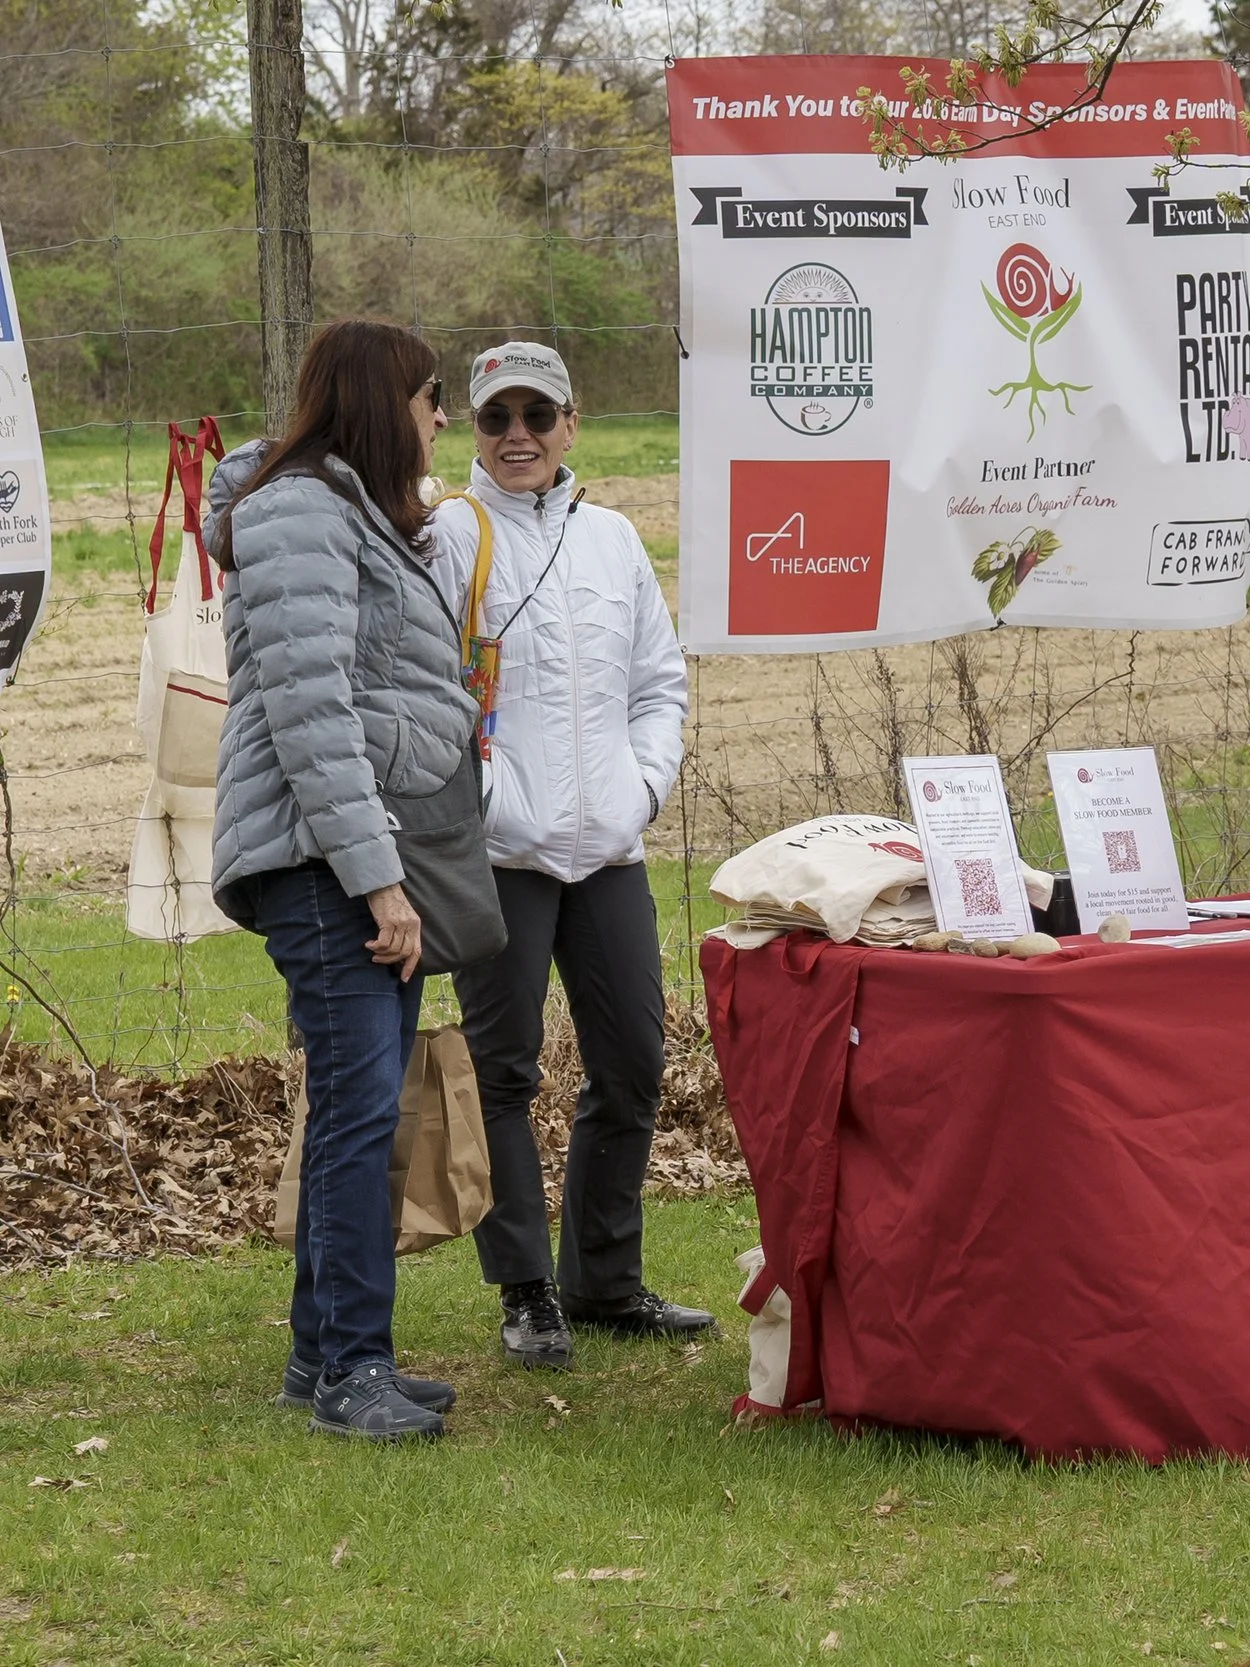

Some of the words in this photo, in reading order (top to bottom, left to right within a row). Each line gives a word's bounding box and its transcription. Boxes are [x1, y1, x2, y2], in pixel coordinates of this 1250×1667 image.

[693, 95, 779, 120] Thank
[785, 95, 833, 118] You
[840, 97, 865, 117] to
[912, 98, 948, 119] 206
[983, 101, 1022, 127] Day
[1028, 101, 1147, 128] Sponsors
[1153, 99, 1170, 120] &
[1175, 98, 1219, 120] Event
[952, 177, 1007, 209] Slow
[1013, 174, 1071, 209] Food
[735, 203, 806, 228] Event
[813, 202, 907, 235] Sponsors
[988, 214, 1019, 229] EAST
[1023, 213, 1047, 227] END
[1164, 203, 1213, 227] Event
[750, 306, 873, 364] HAMPTON
[504, 355, 527, 363] Slow
[750, 366, 873, 382] COFFEE
[755, 385, 869, 396] COMPANY
[980, 459, 1028, 482] Event
[1033, 456, 1096, 479] Partner
[946, 495, 987, 518] Golden
[988, 495, 1022, 516] Acres
[1027, 492, 1071, 518] Organi
[1073, 486, 1118, 508] Farm
[13, 514, 38, 529] Fork
[1, 536, 14, 548] per
[17, 531, 37, 544] Club
[1163, 531, 1198, 550] CAB
[1206, 529, 1245, 549] FRAN
[804, 556, 871, 574] AGENCY
[196, 607, 222, 625] Slo
[1095, 768, 1113, 778] Slow
[1115, 766, 1135, 777] Food
[943, 780, 967, 795] Slow
[968, 777, 993, 794] Food
[1091, 797, 1124, 806] BECOME
[1125, 796, 1131, 805] A
[1074, 810, 1096, 820] SLOW
[1097, 809, 1119, 819] FOOD
[1120, 807, 1153, 817] MEMBER
[864, 822, 918, 835] low
[1087, 890, 1099, 898] Join
[1101, 890, 1116, 899] today
[1117, 889, 1126, 897] for
[1127, 888, 1138, 896] $15
[1150, 887, 1172, 895] support
[1090, 900, 1104, 908] local
[1105, 899, 1135, 907] movement
[1136, 897, 1154, 905] rooted
[1151, 905, 1160, 913] for
